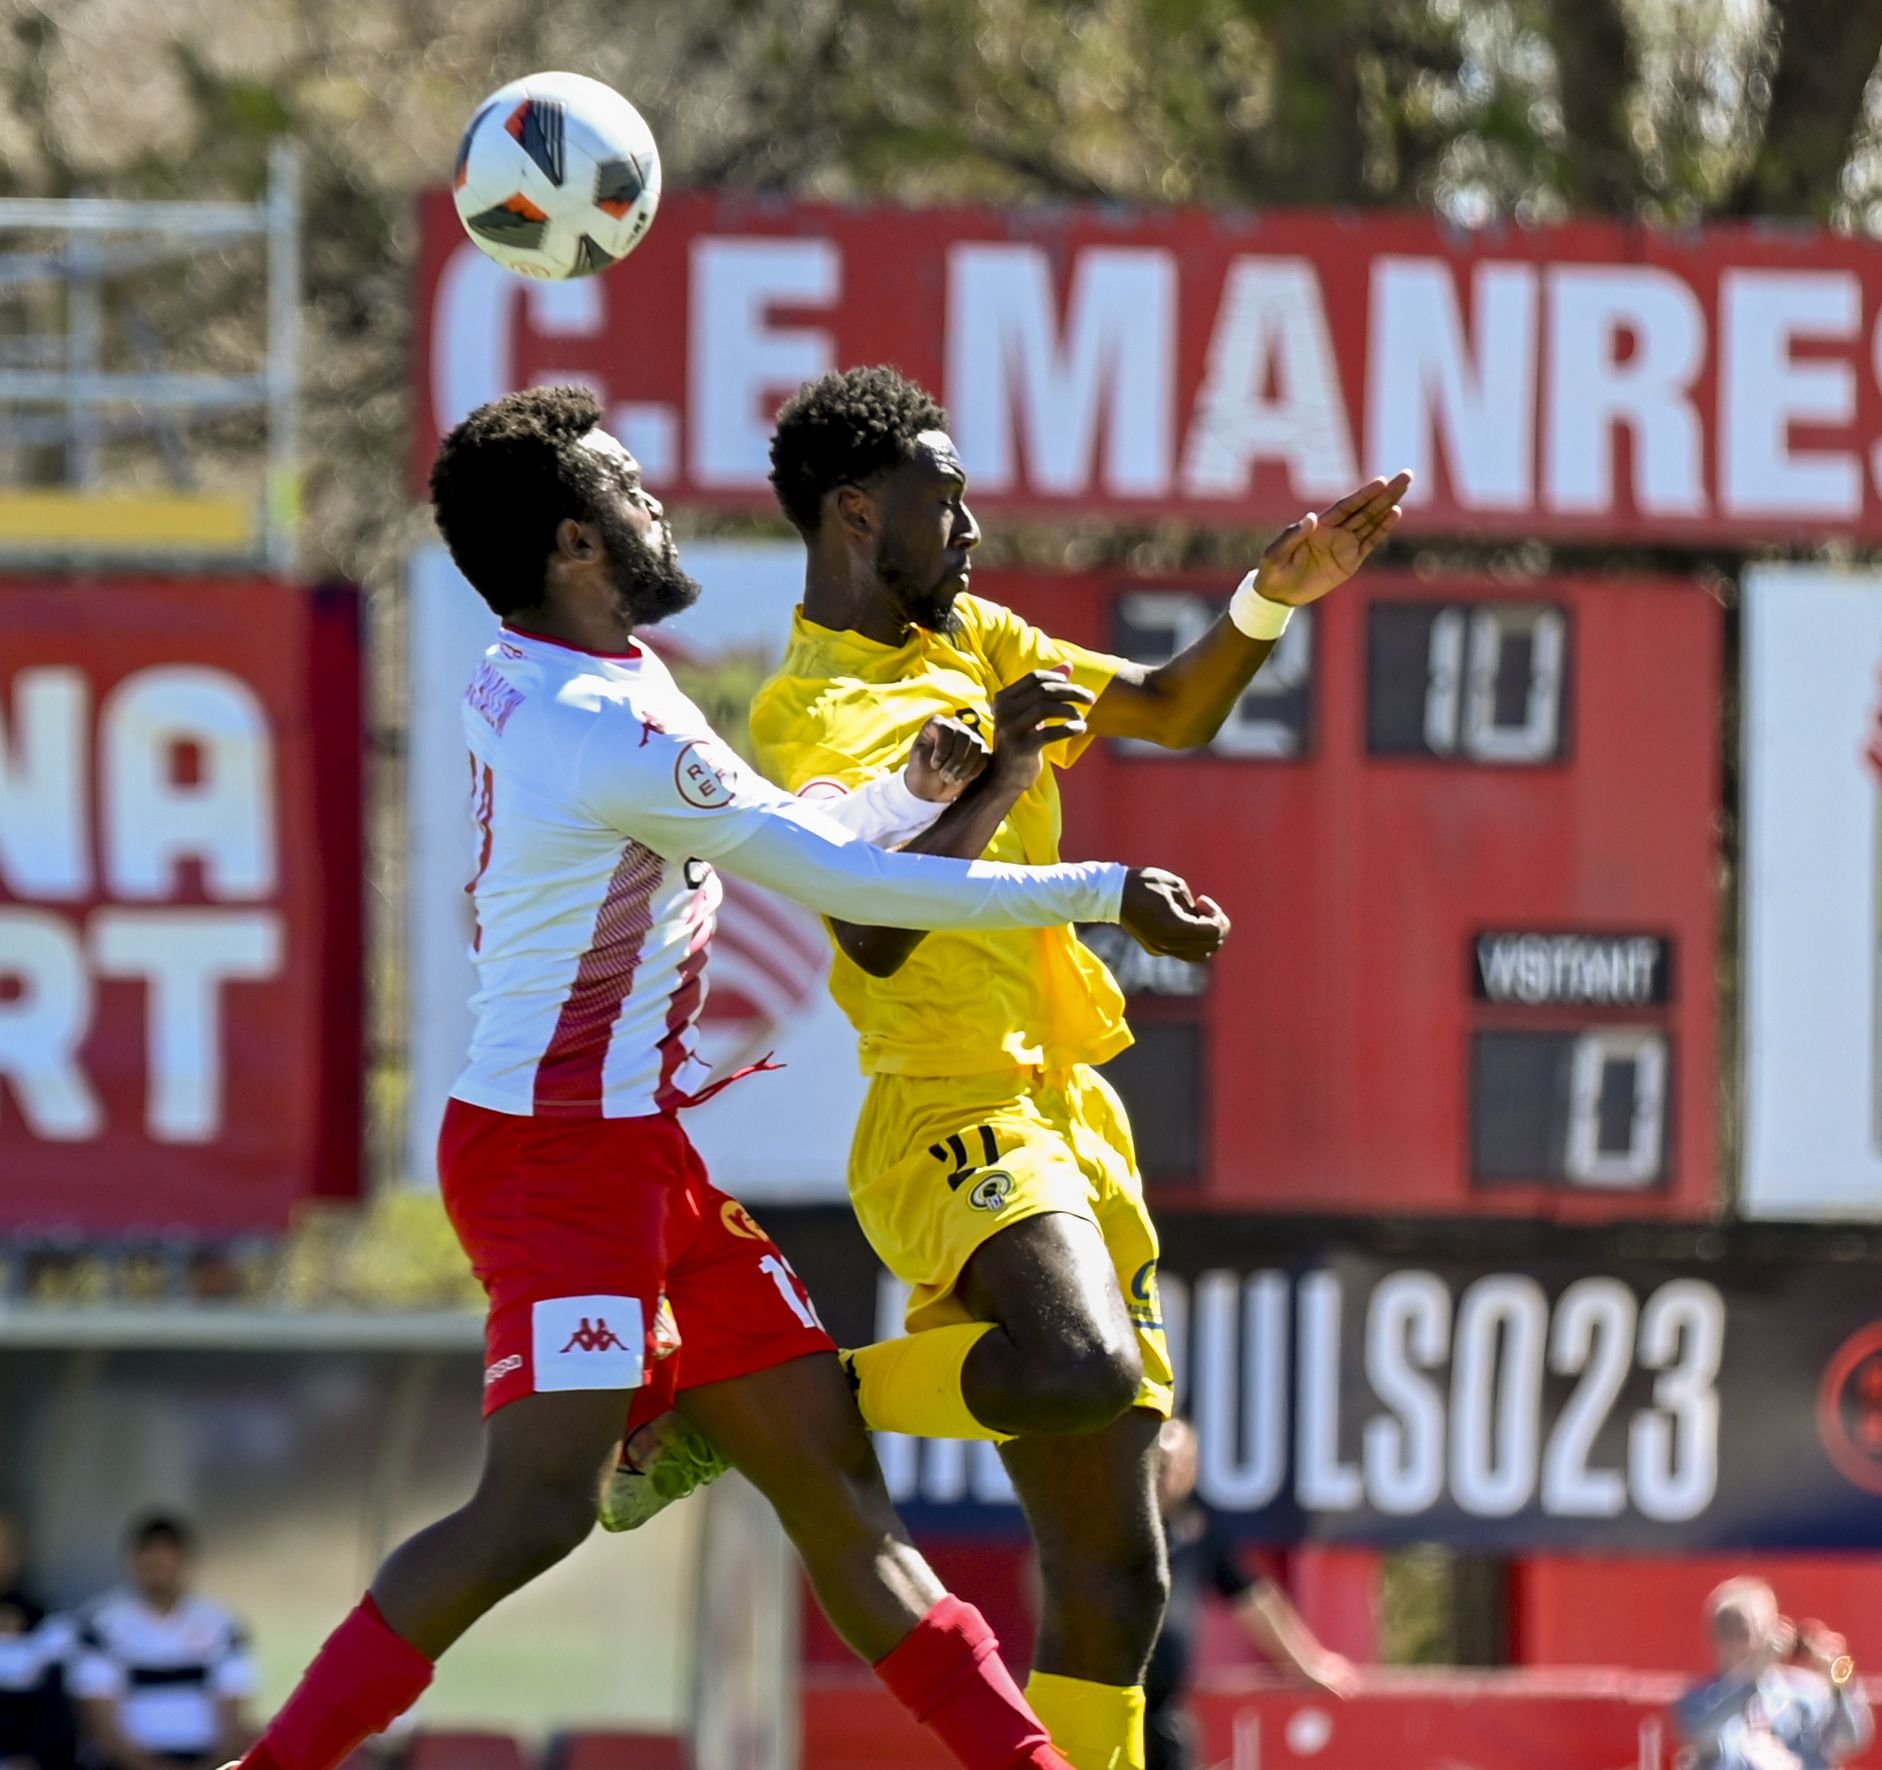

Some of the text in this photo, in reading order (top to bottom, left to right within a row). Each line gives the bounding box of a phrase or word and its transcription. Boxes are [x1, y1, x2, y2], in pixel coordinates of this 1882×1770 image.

[944, 240, 1882, 522] MANRE
[1424, 604, 1566, 764] 10
[1563, 1028, 1668, 1190] 0
[758, 1253, 826, 1332] 1
